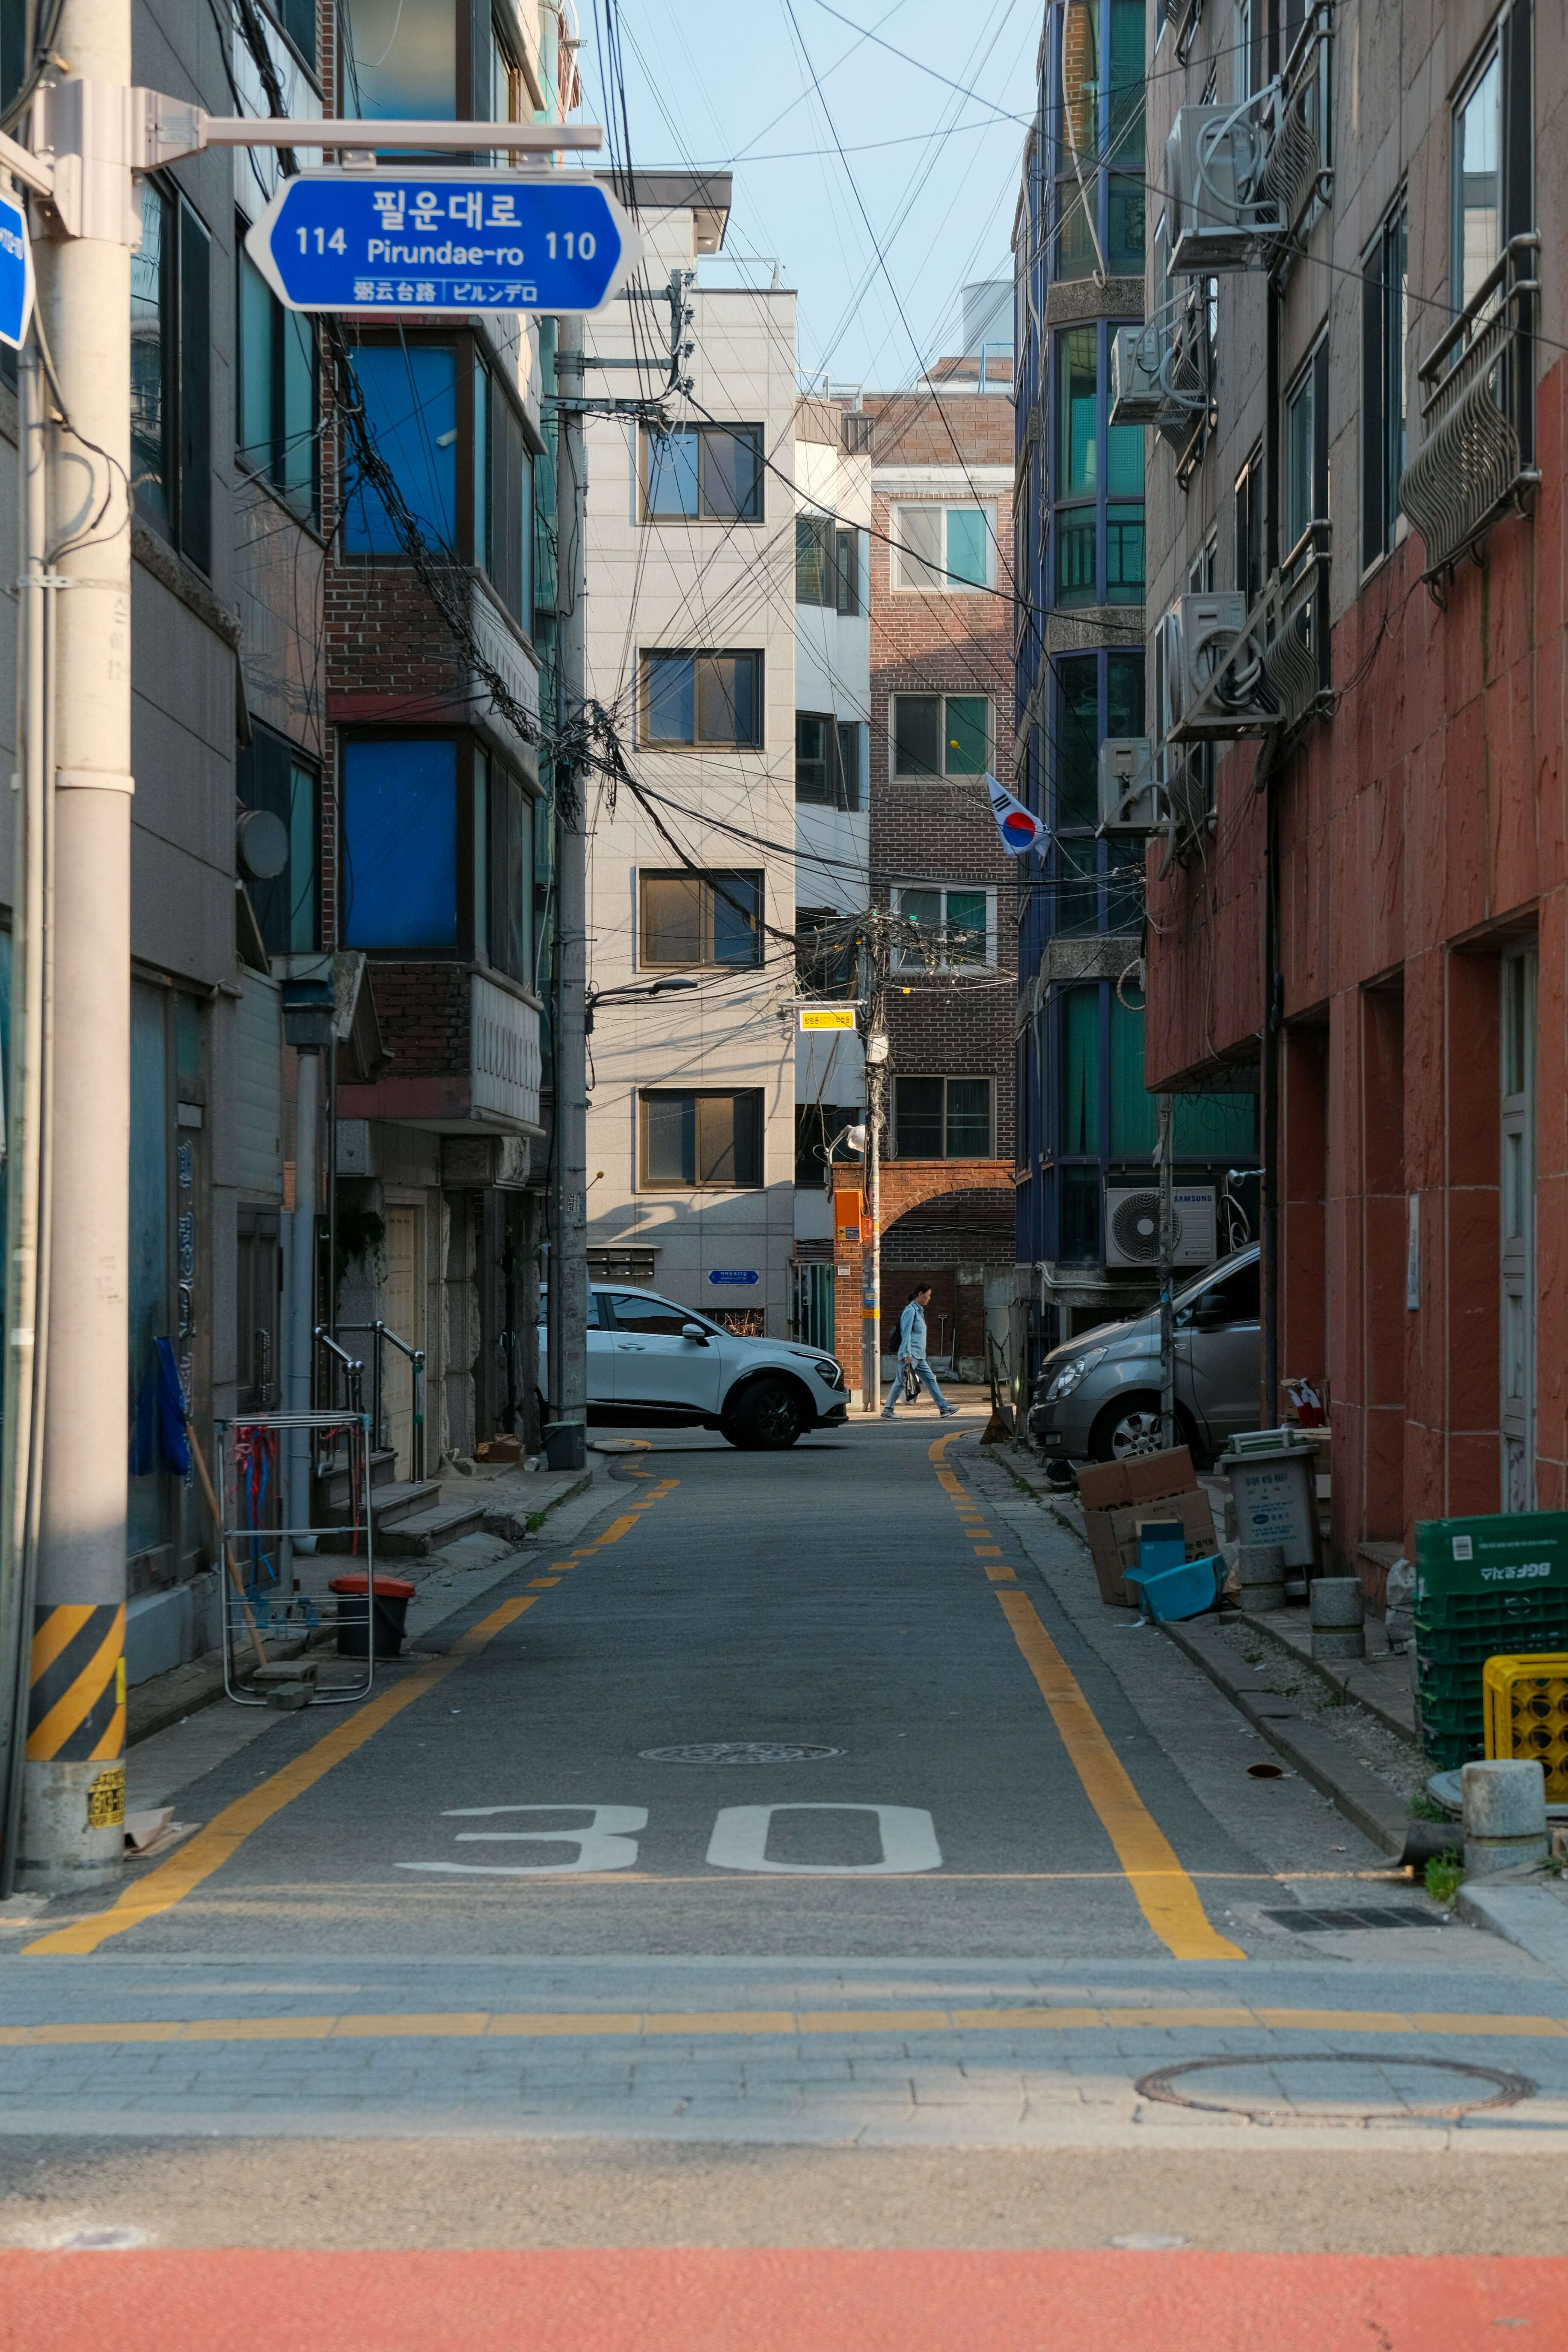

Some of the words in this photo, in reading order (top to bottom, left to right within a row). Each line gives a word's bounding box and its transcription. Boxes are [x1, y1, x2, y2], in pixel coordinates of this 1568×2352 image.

[372, 189, 522, 231] 필운대로
[296, 227, 347, 255] 114
[368, 239, 524, 266] Pirundae-ro
[546, 232, 596, 260] 110
[454, 283, 537, 302] ピルンデロ
[1480, 1562, 1551, 1580] BGF로지스
[393, 1803, 942, 1875] 30
